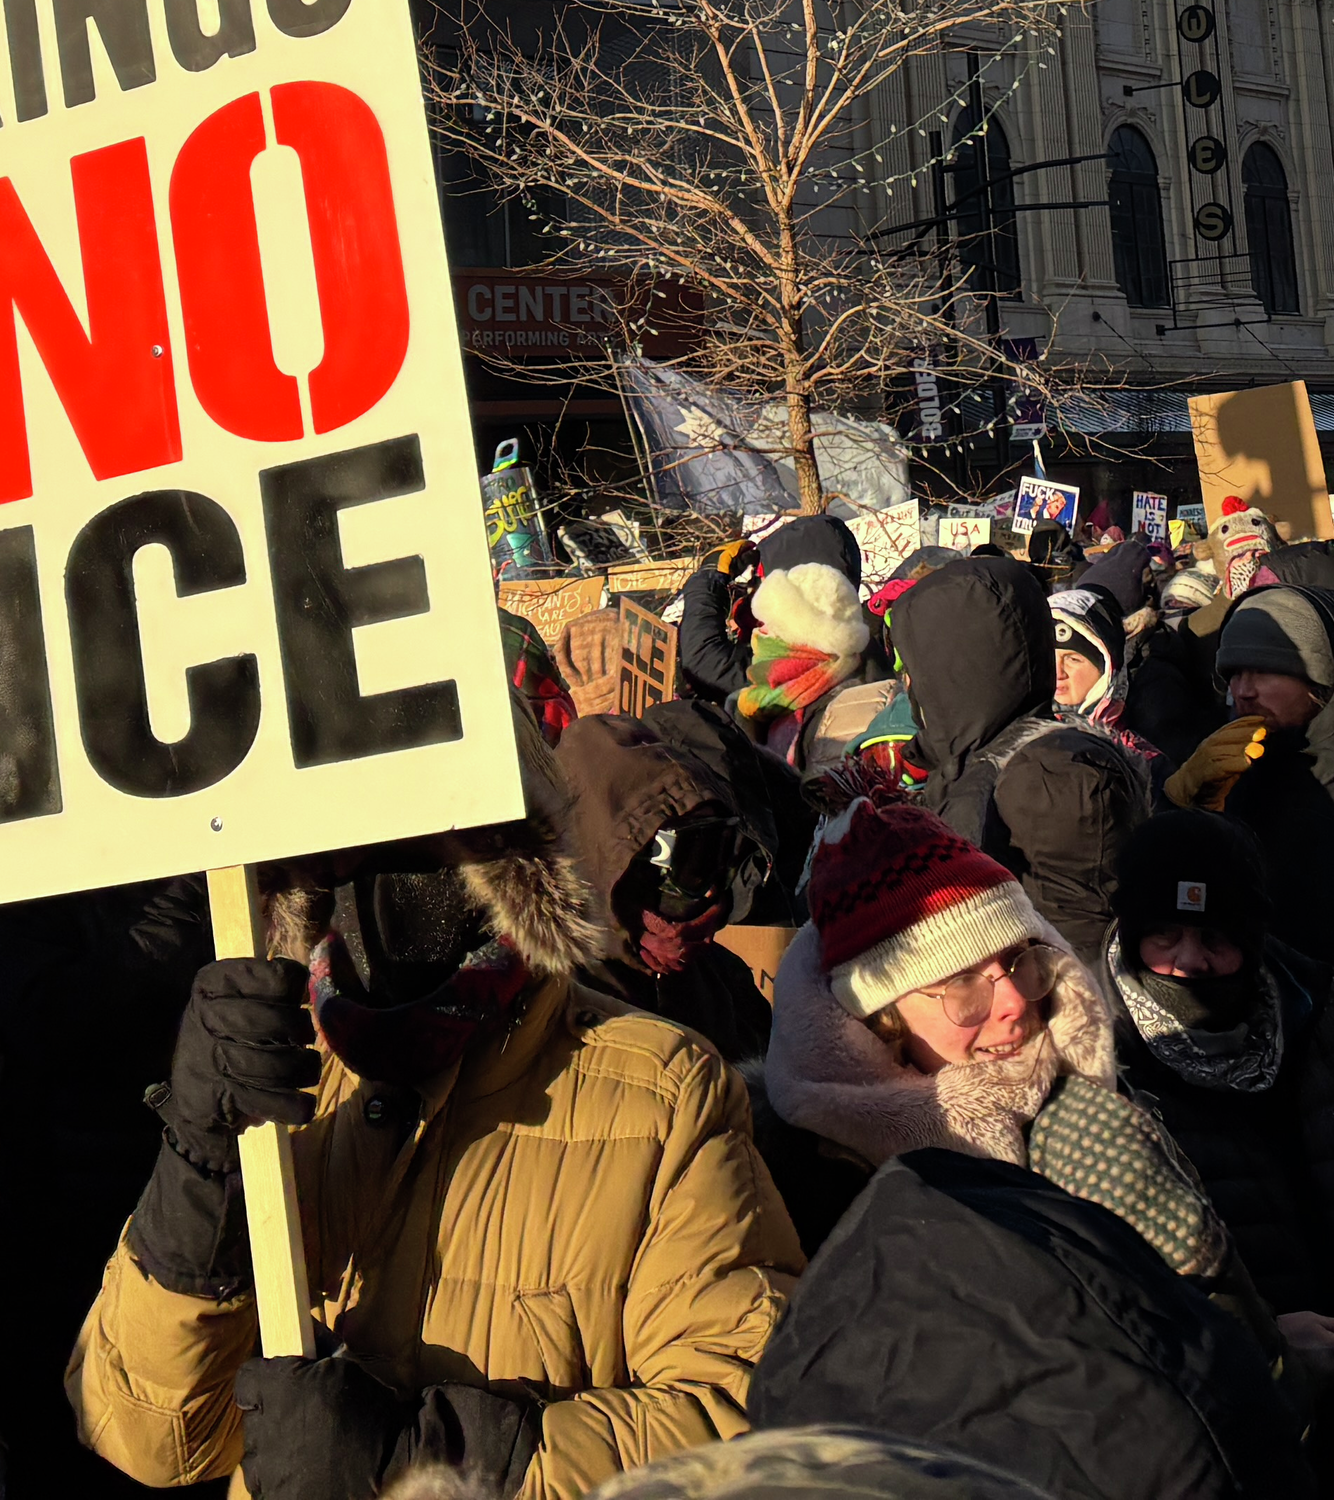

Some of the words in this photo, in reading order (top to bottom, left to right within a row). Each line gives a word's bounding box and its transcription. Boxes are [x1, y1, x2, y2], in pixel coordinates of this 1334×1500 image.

[467, 284, 617, 323] CENTER
[577, 330, 616, 347] ART
[1022, 482, 1056, 501] FUCK
[1136, 494, 1166, 512] HATE
[1144, 511, 1155, 522] IS
[949, 522, 981, 536] USA
[1139, 520, 1162, 534] NOT
[622, 607, 668, 687] ICE
